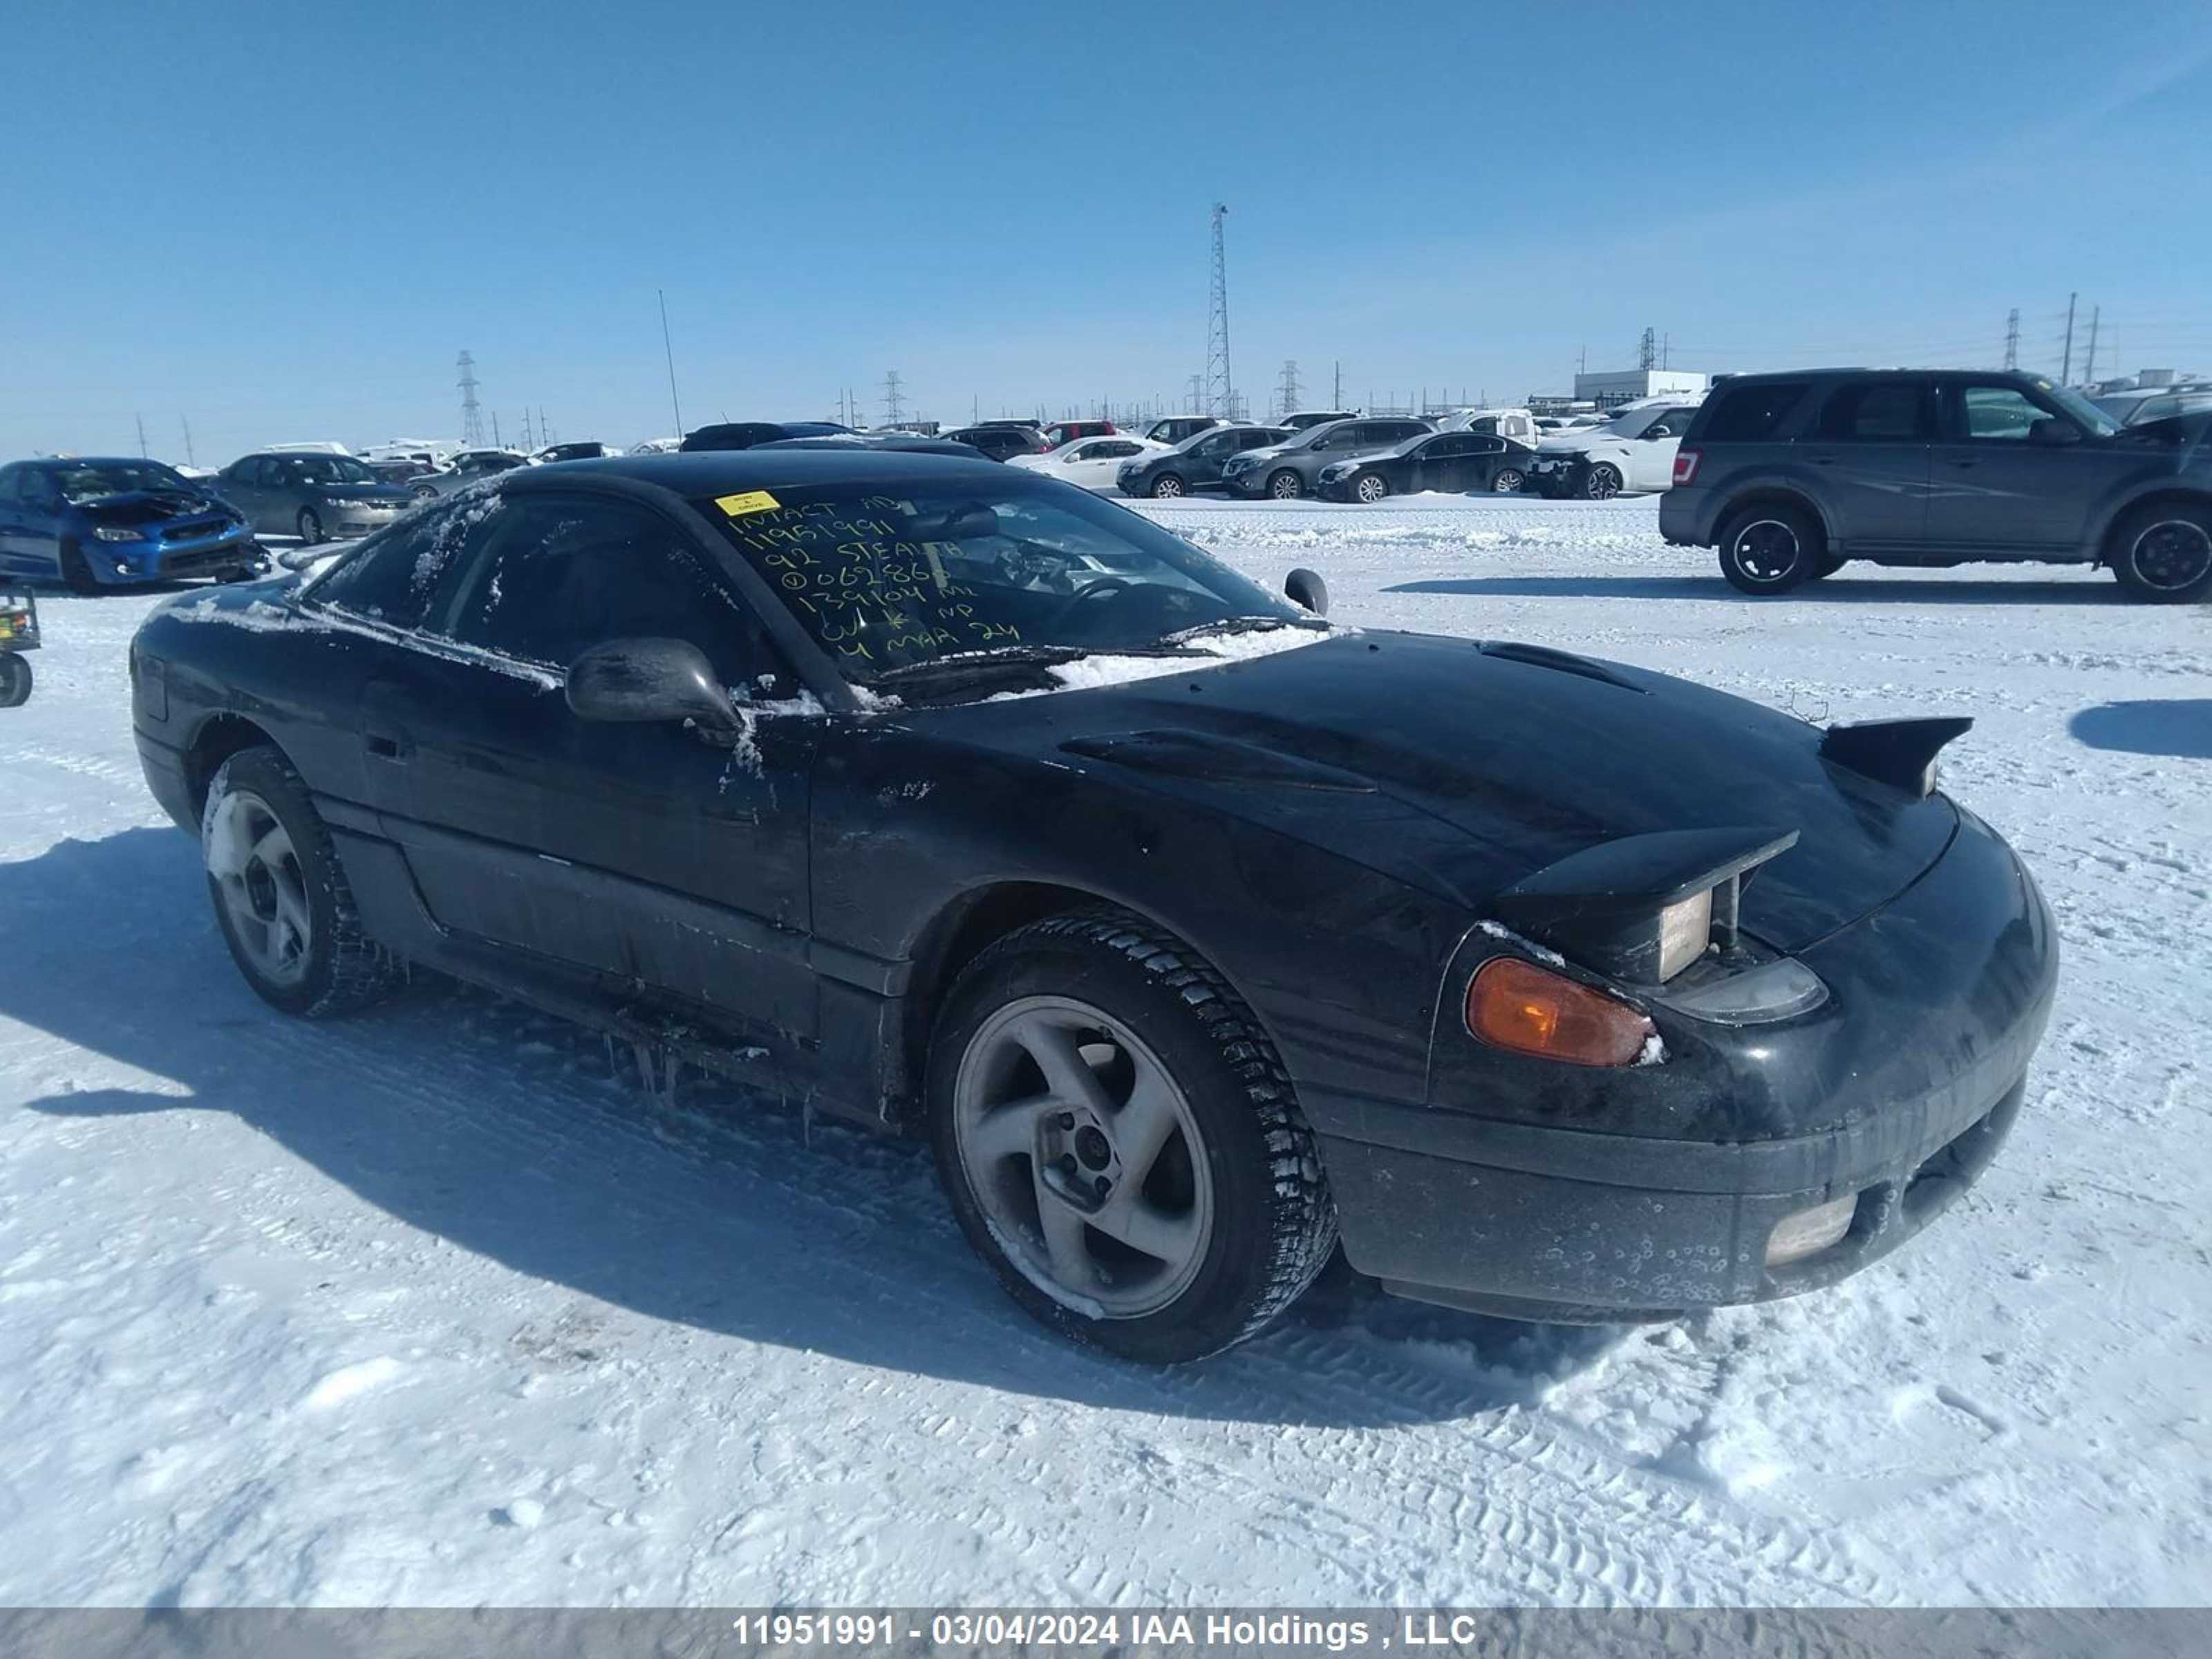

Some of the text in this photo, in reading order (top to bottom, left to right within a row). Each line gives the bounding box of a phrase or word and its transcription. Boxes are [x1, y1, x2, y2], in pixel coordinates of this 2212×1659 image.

[728, 503, 836, 534] INTACT
[744, 518, 895, 550] 11951991
[765, 547, 821, 569] 92
[798, 585, 927, 613] 139104
[887, 628, 961, 651] MAR
[968, 622, 1021, 641] 24
